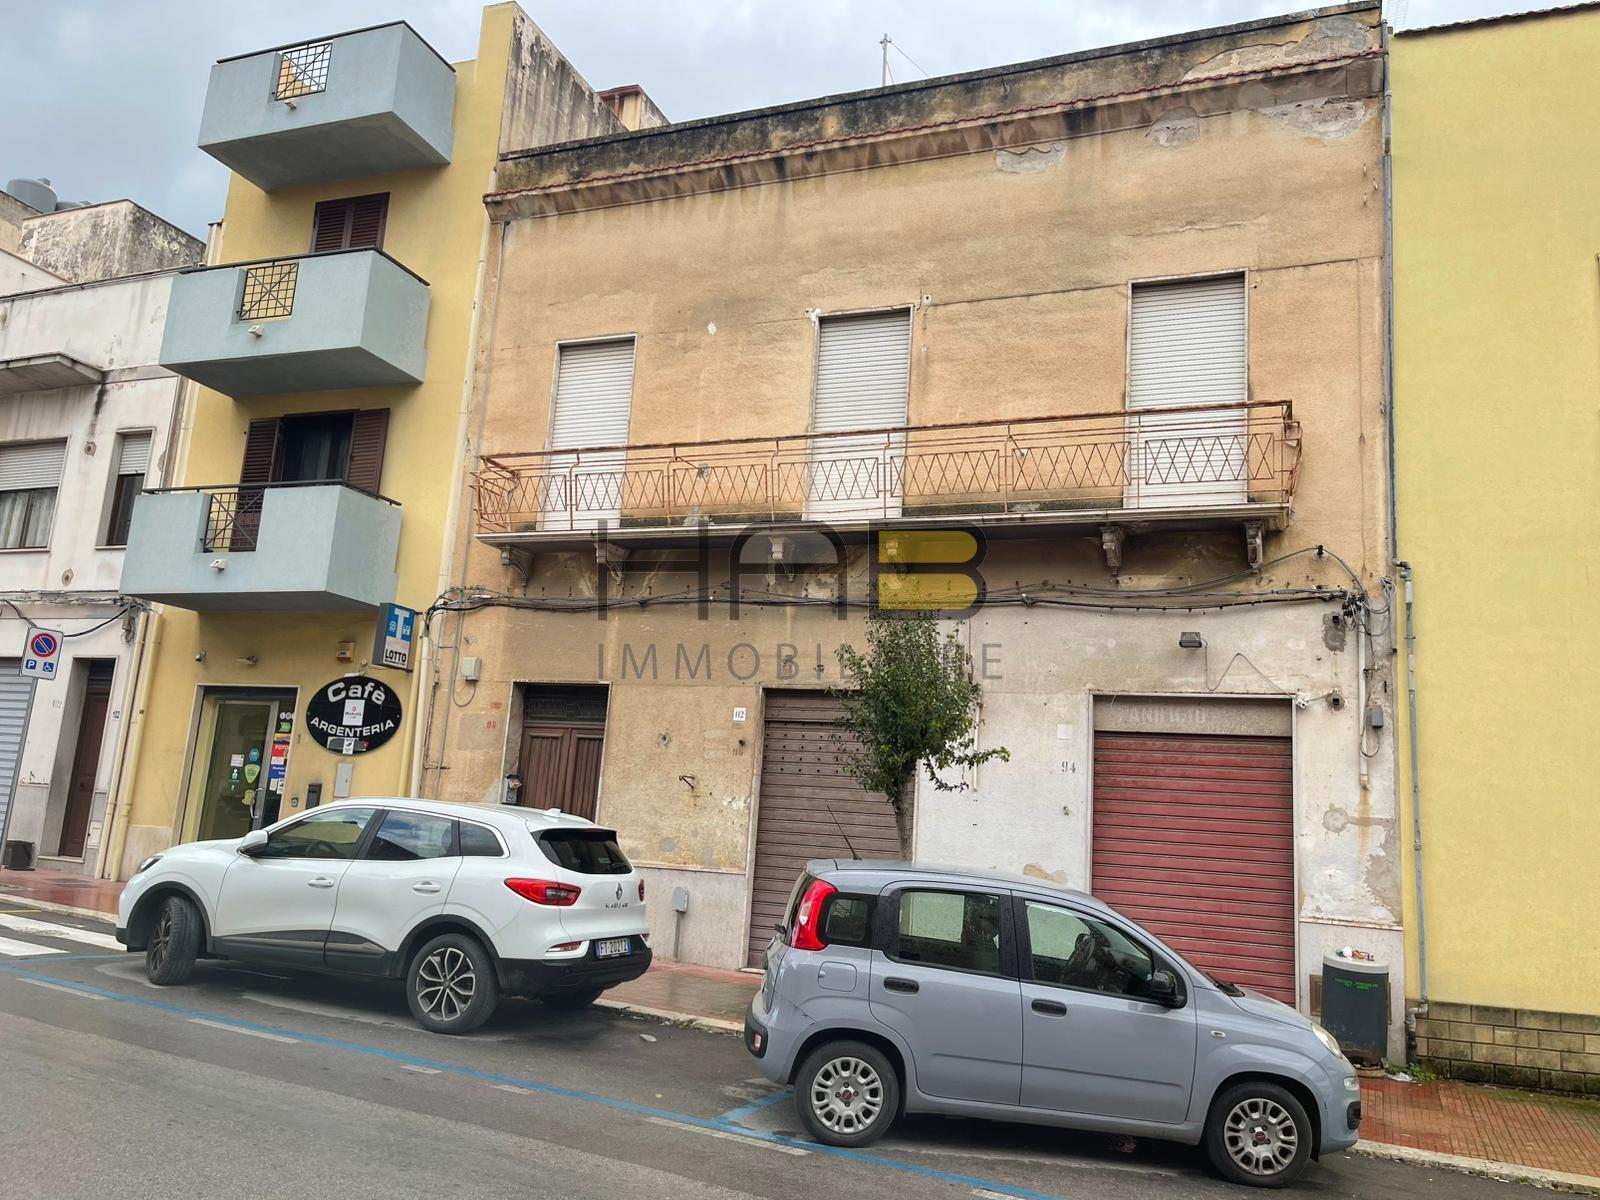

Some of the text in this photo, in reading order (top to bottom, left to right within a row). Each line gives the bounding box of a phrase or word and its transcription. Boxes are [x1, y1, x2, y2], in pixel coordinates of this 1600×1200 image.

[27, 660, 36, 668] P
[385, 649, 407, 663] LOTTO
[327, 682, 386, 705] Cafè
[310, 717, 395, 737] ARGENTERIA
